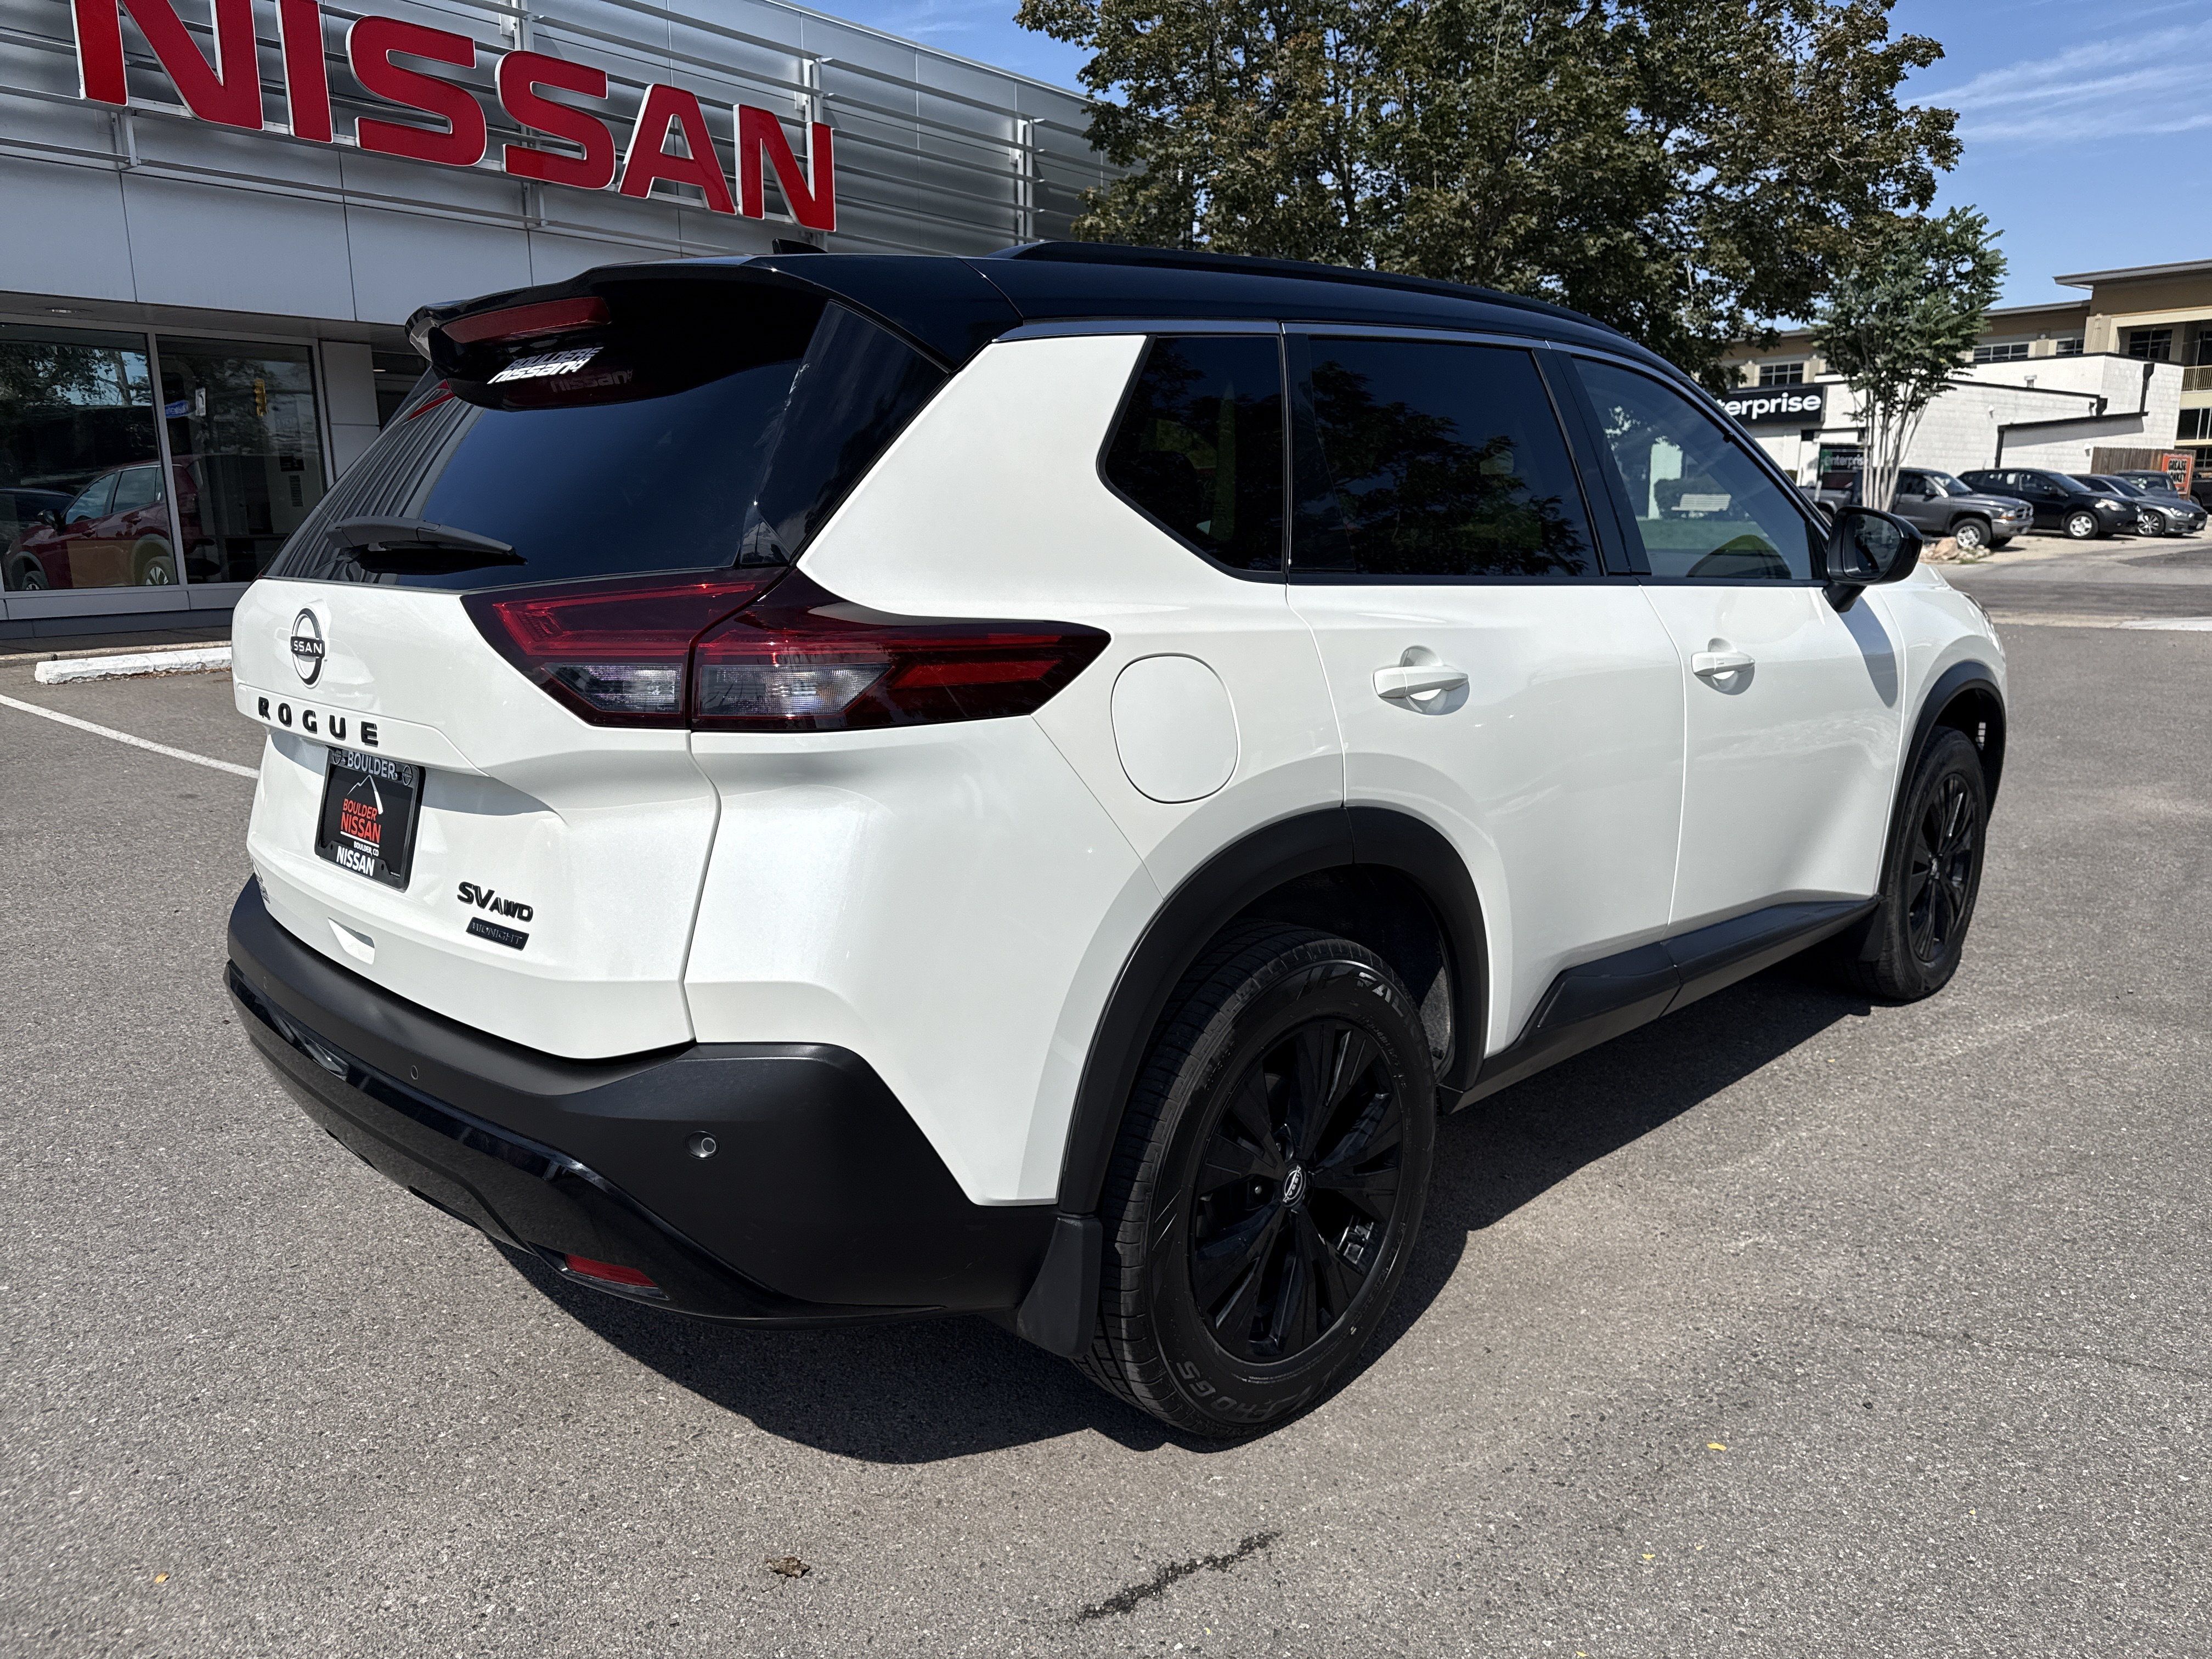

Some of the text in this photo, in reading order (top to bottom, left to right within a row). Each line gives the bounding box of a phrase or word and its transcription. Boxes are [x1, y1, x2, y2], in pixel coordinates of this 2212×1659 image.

[74, 0, 837, 233] NISSAN
[505, 347, 596, 370] BOULDER
[258, 696, 379, 748] ROGUE
[347, 751, 397, 780] BOULDER
[342, 798, 377, 821] BOULDER
[341, 812, 381, 843] NISSAN
[336, 845, 375, 877] NISSAN
[353, 841, 379, 857] BOULDER, CO
